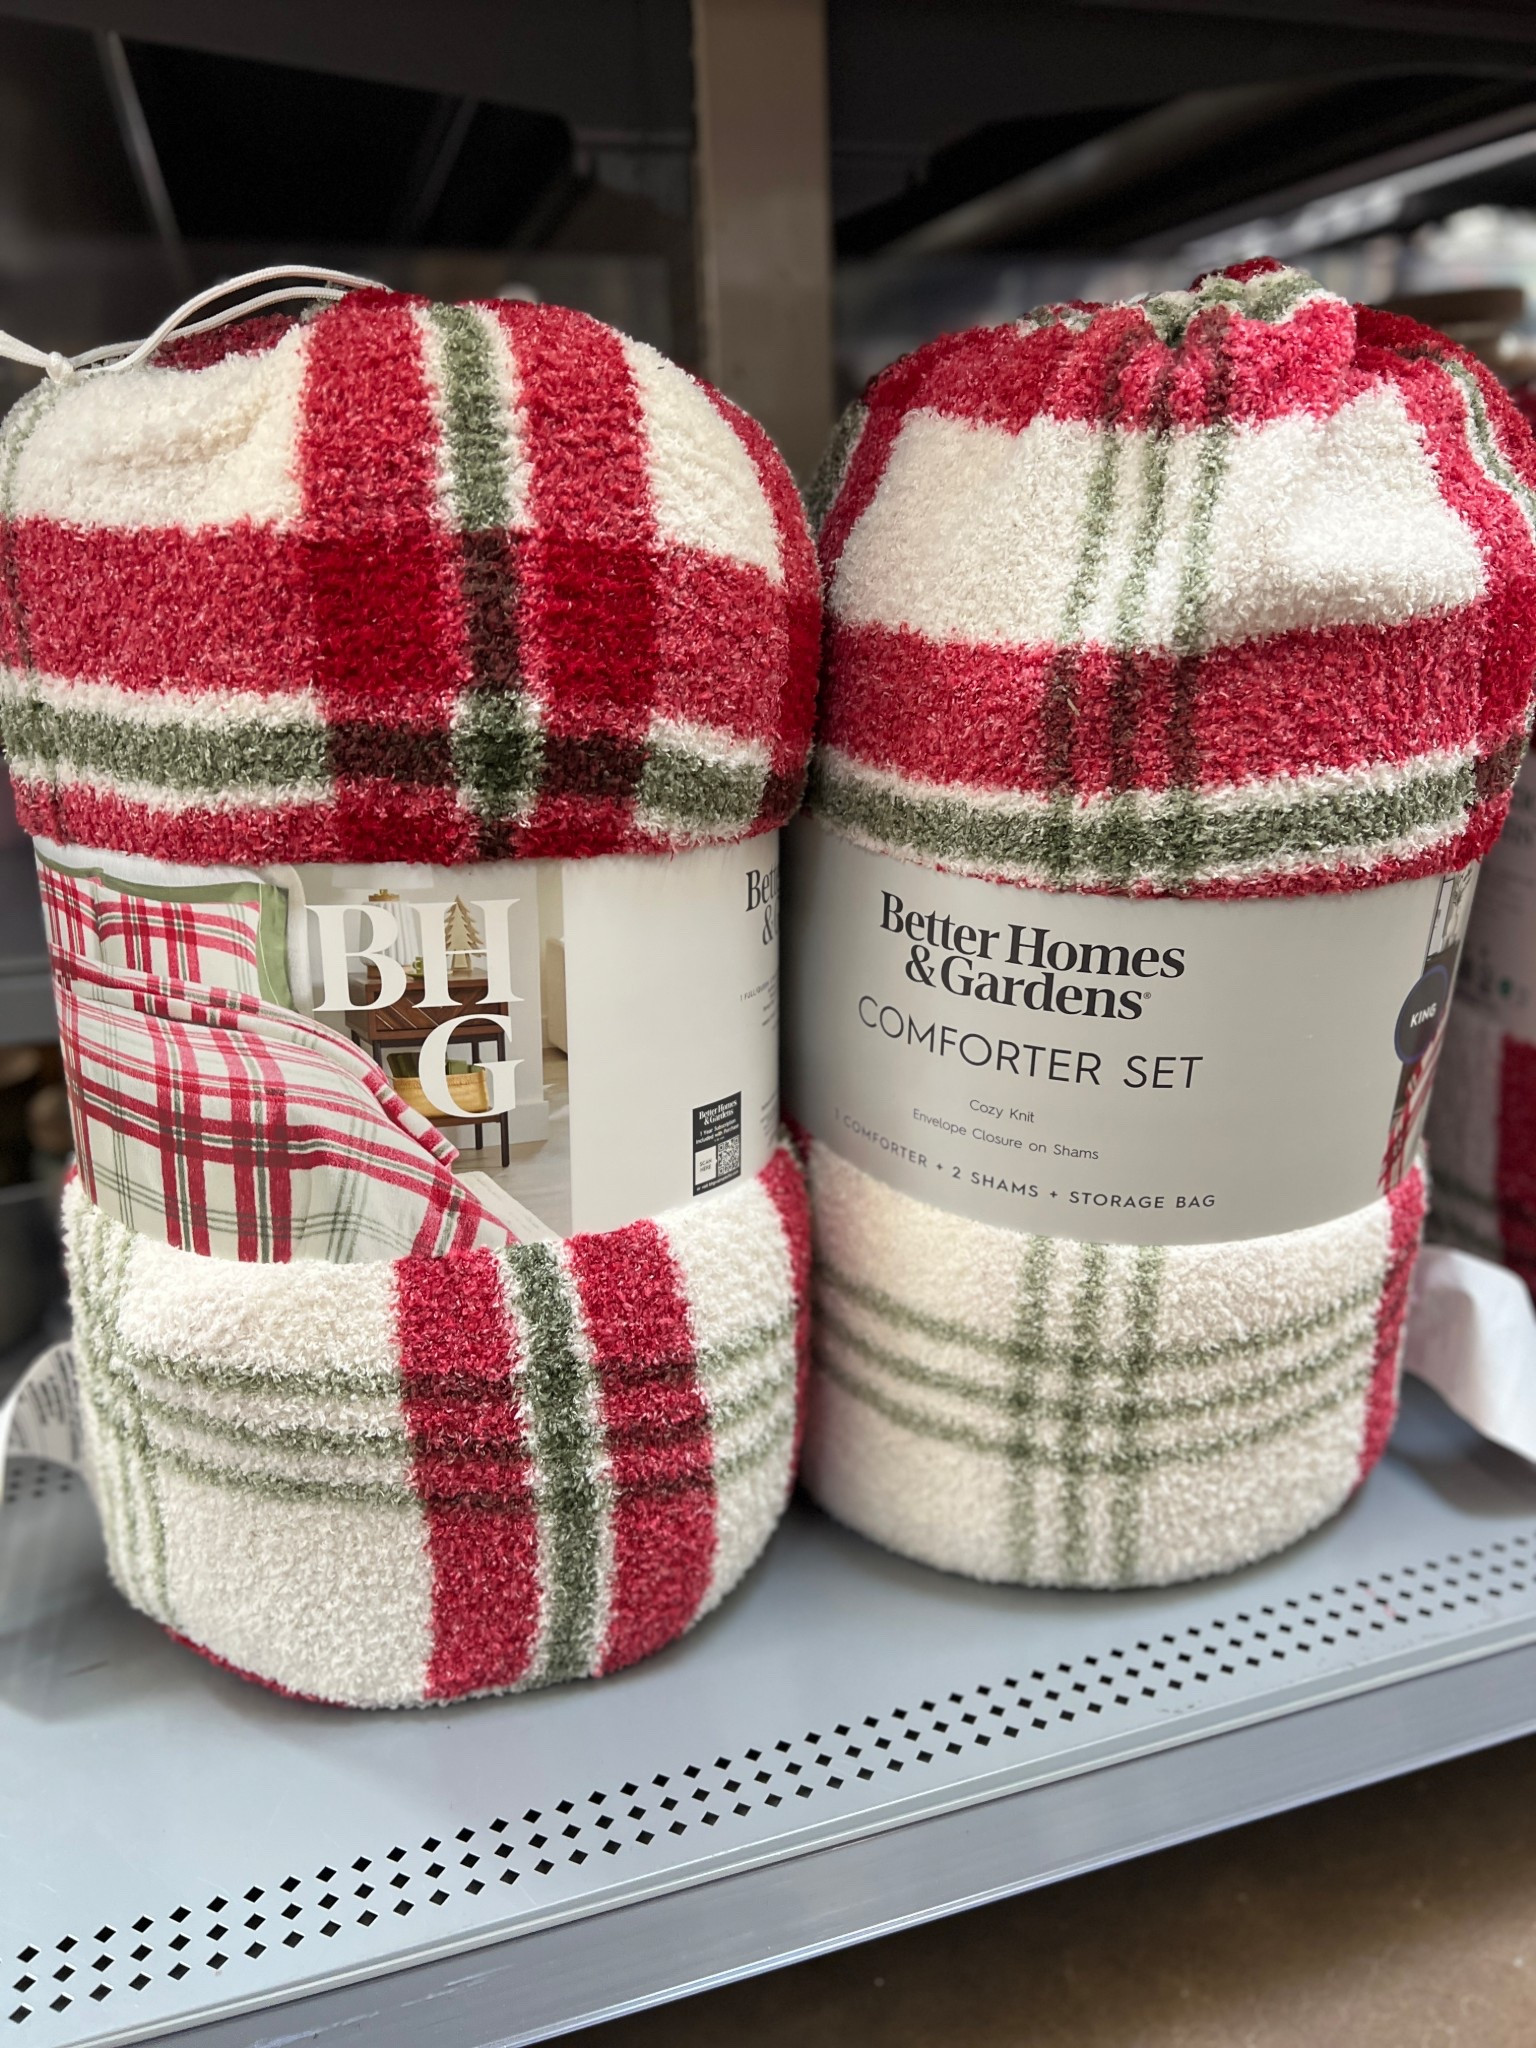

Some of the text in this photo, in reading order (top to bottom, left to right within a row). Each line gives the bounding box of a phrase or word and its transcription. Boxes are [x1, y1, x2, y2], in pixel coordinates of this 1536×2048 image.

[879, 889, 1186, 979] Better Homes
[857, 994, 1204, 1089] COMFORTER SET
[1409, 1001, 1438, 1028] KING
[418, 1014, 525, 1119] G
[969, 1099, 1035, 1124] Cozy Knit
[842, 1115, 928, 1168] COMFORTER
[952, 1165, 962, 1180] 2
[970, 1171, 1039, 1198] SHAMS
[1068, 1190, 1166, 1209] STORAGE
[1175, 1194, 1216, 1209] BAG
[912, 1107, 1100, 1161] Envelope Closure on Shams
